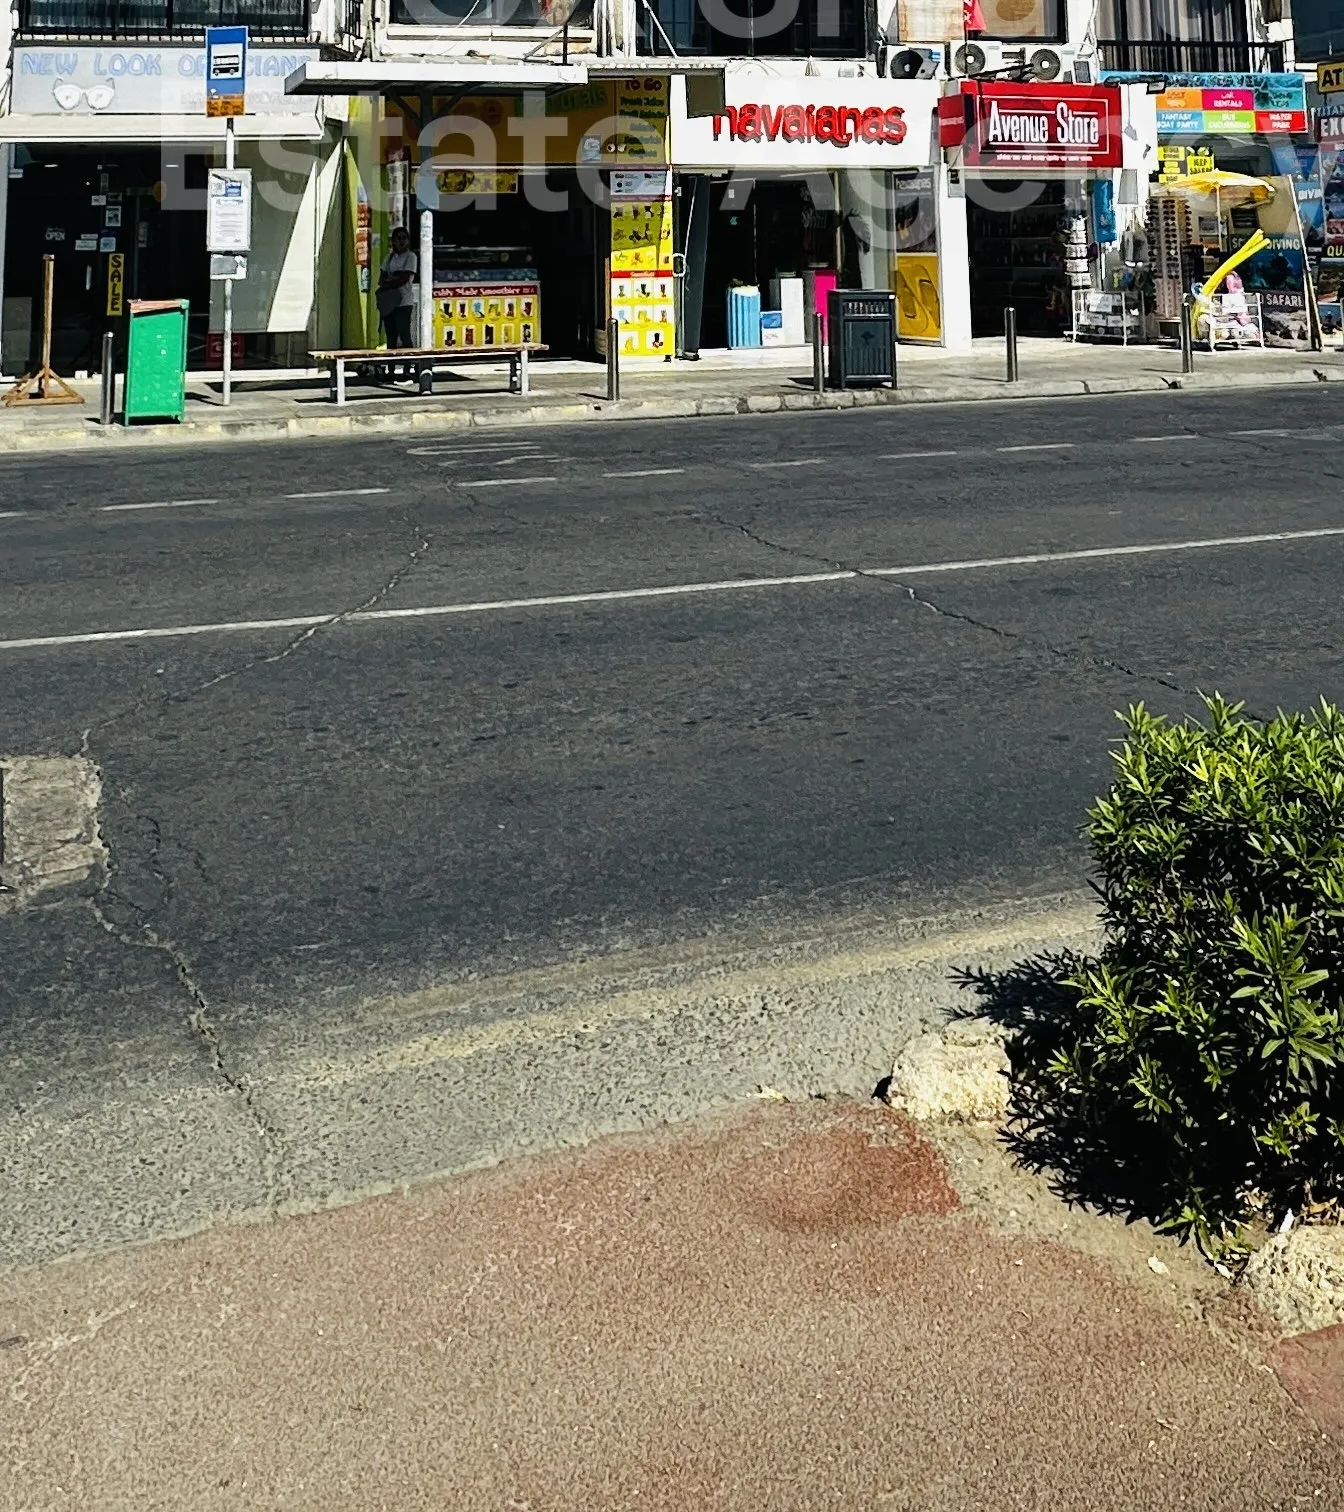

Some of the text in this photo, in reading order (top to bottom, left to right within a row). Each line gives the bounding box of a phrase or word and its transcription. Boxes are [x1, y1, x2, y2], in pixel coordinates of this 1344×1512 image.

[20, 52, 79, 76] NEW
[94, 52, 162, 76] LOOK
[989, 100, 1099, 144] Avenue Store
[45, 230, 66, 241] OPEN
[110, 254, 123, 313] SALE
[1266, 294, 1304, 308] SAFARI
